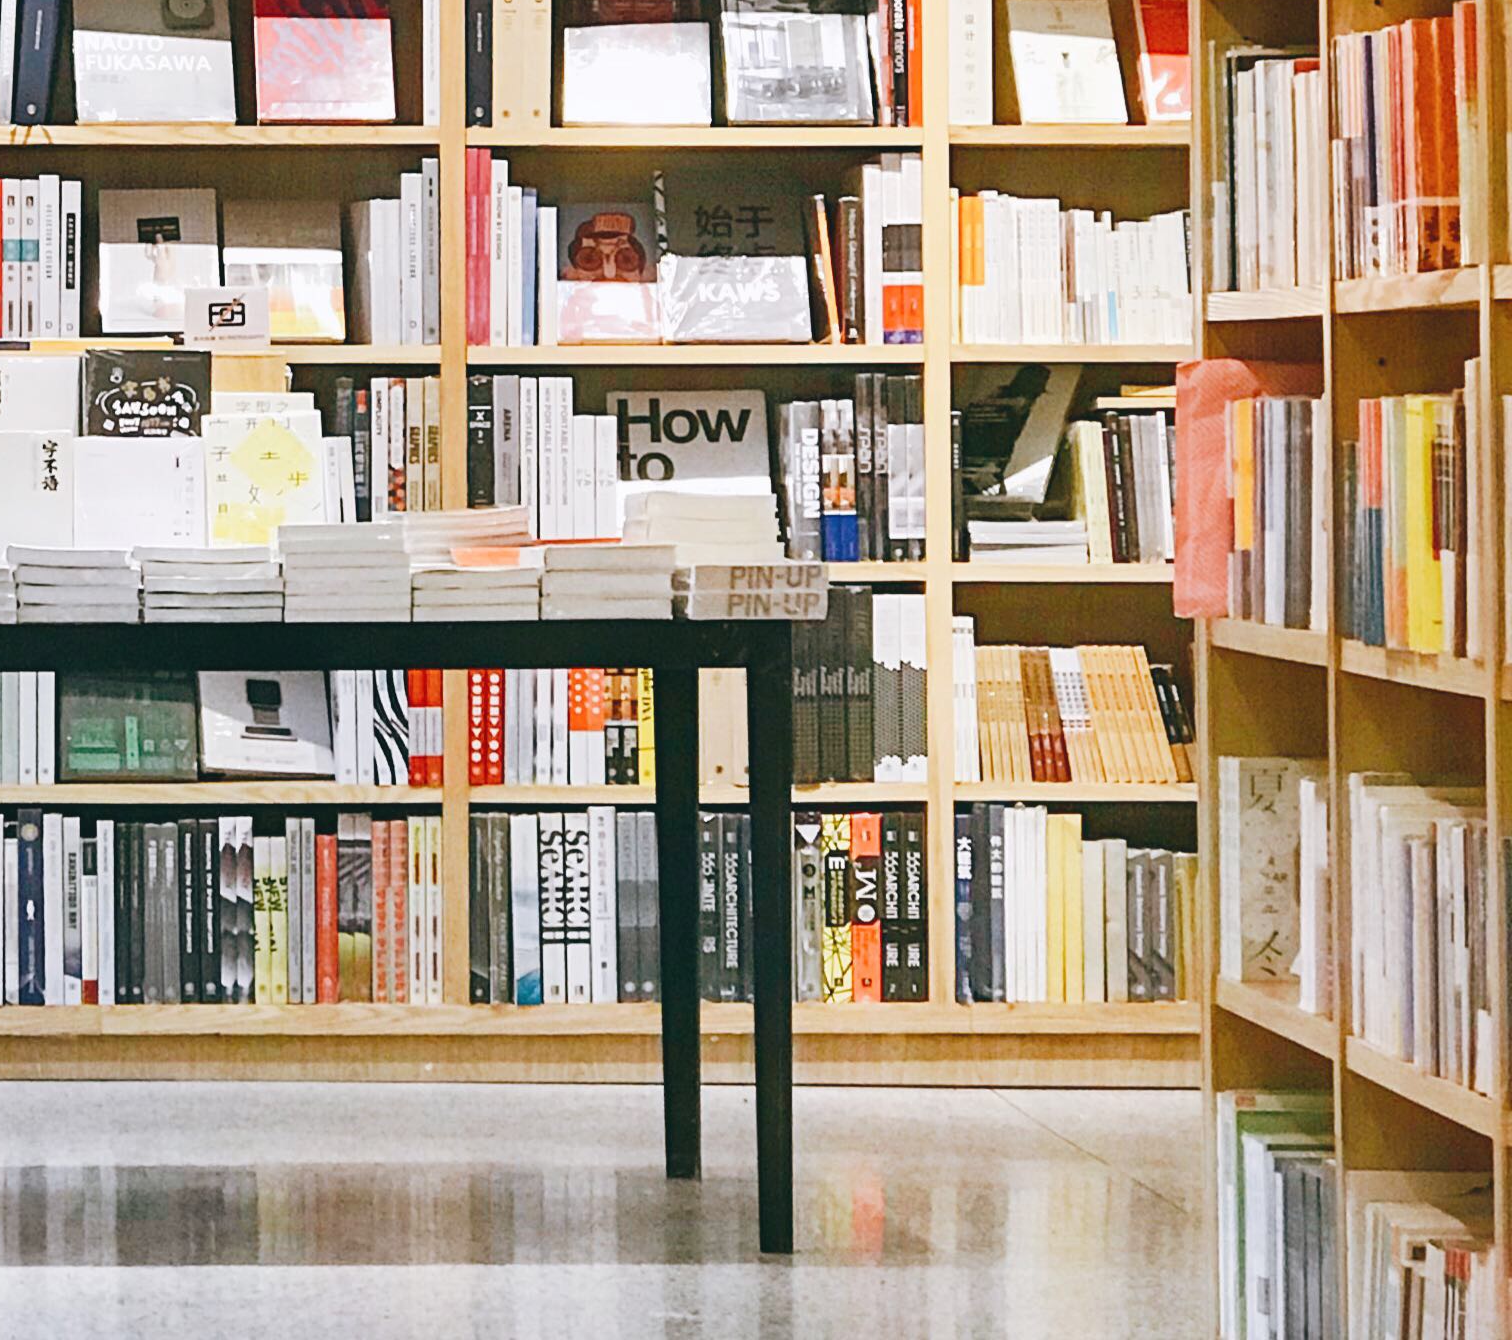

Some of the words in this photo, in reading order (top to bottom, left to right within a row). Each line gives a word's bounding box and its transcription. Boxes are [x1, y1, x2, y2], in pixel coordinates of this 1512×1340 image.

[86, 34, 164, 51] NAOTO
[85, 54, 212, 71] FUKASAWA
[693, 205, 774, 239] 始于
[698, 281, 780, 304] KAWS
[473, 411, 486, 422] X
[502, 408, 512, 442] ARENA
[617, 398, 751, 444] How
[409, 425, 420, 464] GRAPHICS
[427, 425, 438, 464] GRAPHICS
[617, 444, 675, 481] to
[801, 428, 819, 519] DESIGN
[728, 565, 822, 590] PIN-UP
[726, 592, 820, 617] PIN-UP
